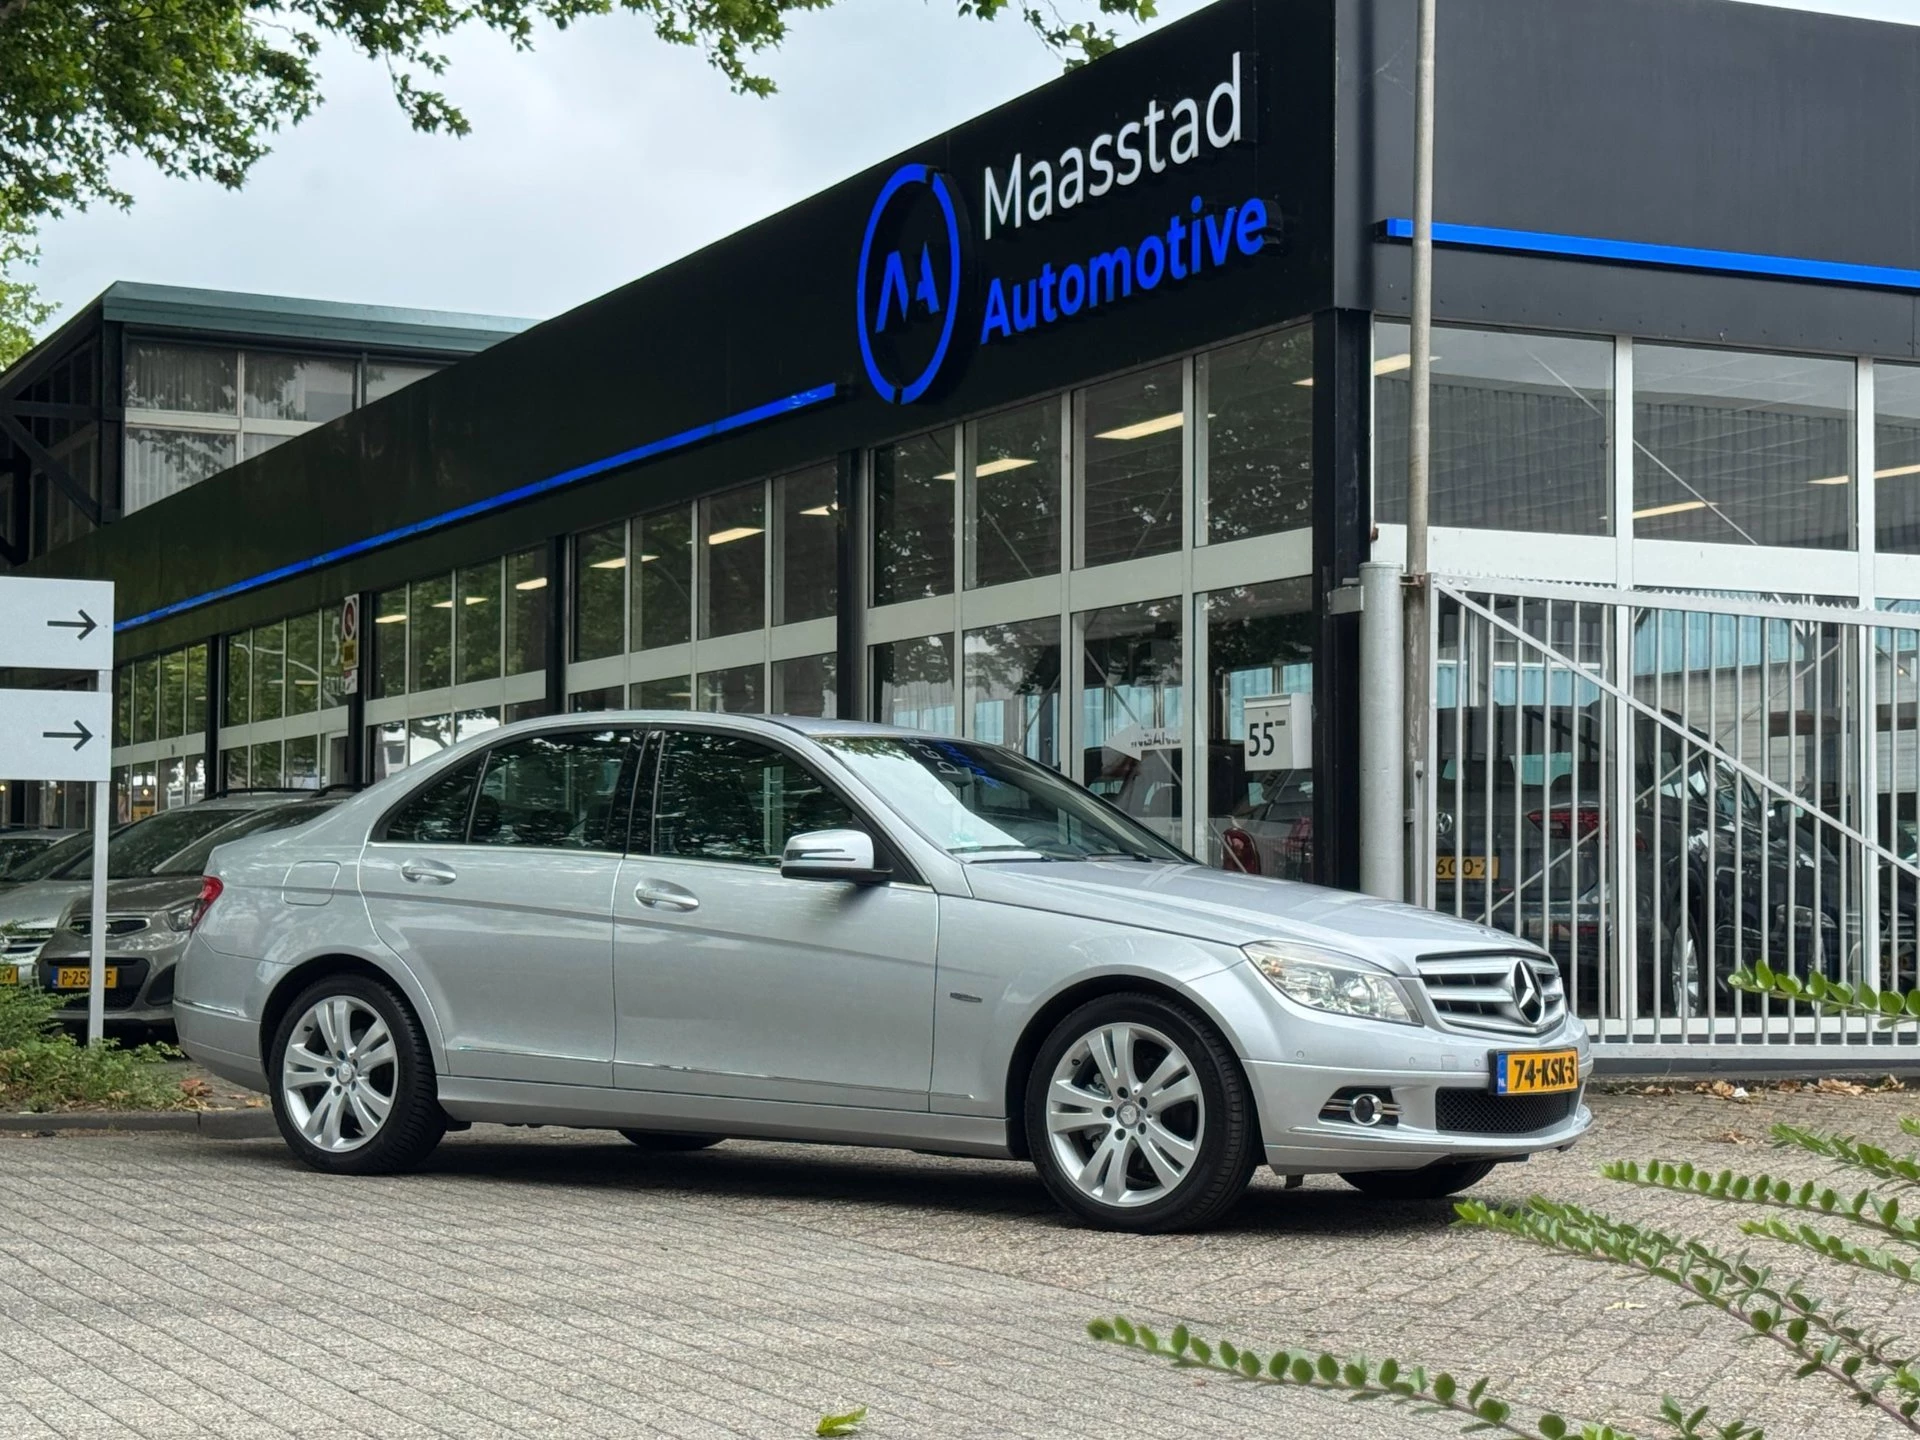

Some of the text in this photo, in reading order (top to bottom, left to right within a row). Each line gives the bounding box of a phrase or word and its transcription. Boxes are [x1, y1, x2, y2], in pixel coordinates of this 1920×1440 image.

[984, 51, 1242, 241] Maasstad
[980, 195, 1268, 345] Automotive
[1249, 721, 1275, 757] 55
[1514, 1055, 1575, 1090] 74-KSK-3
